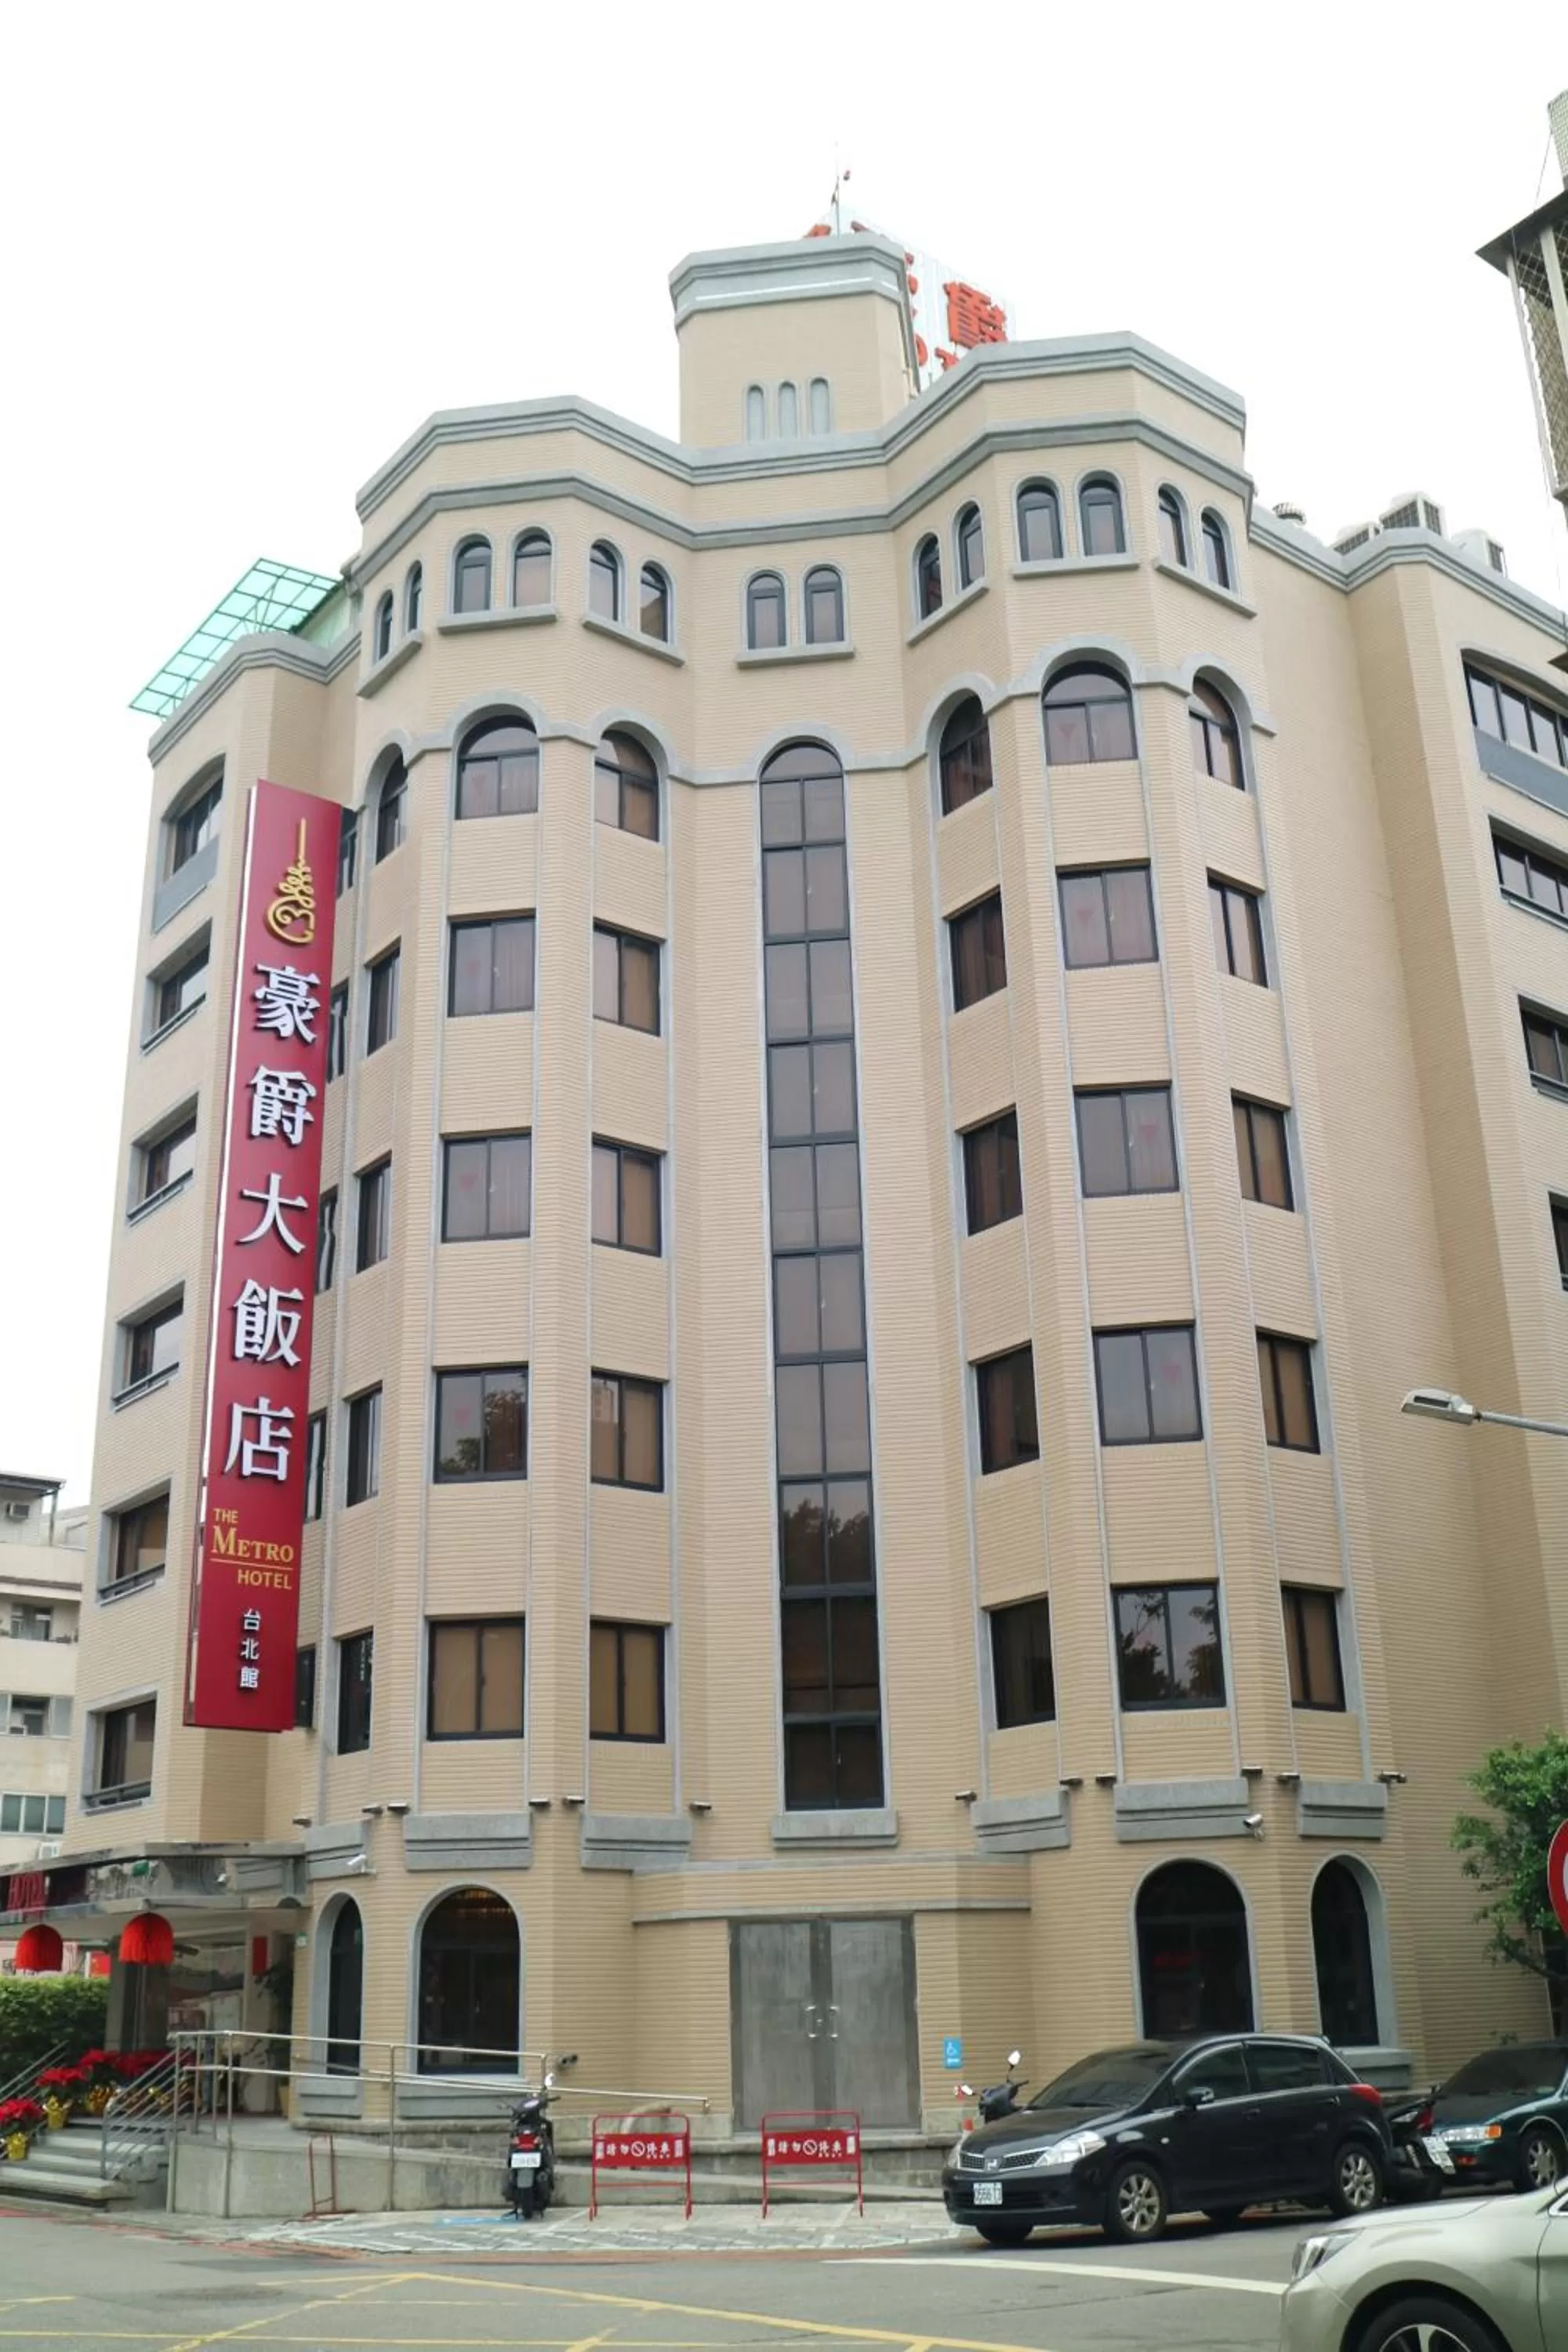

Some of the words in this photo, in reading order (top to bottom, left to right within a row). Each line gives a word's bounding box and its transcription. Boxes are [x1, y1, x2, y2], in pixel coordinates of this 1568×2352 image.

[225, 963, 320, 1481] 豪爵大飯店
[212, 1507, 238, 1524] THE
[211, 1525, 294, 1563] METRO
[238, 1568, 292, 1590] HOTEL
[240, 1608, 261, 1690] 台北館
